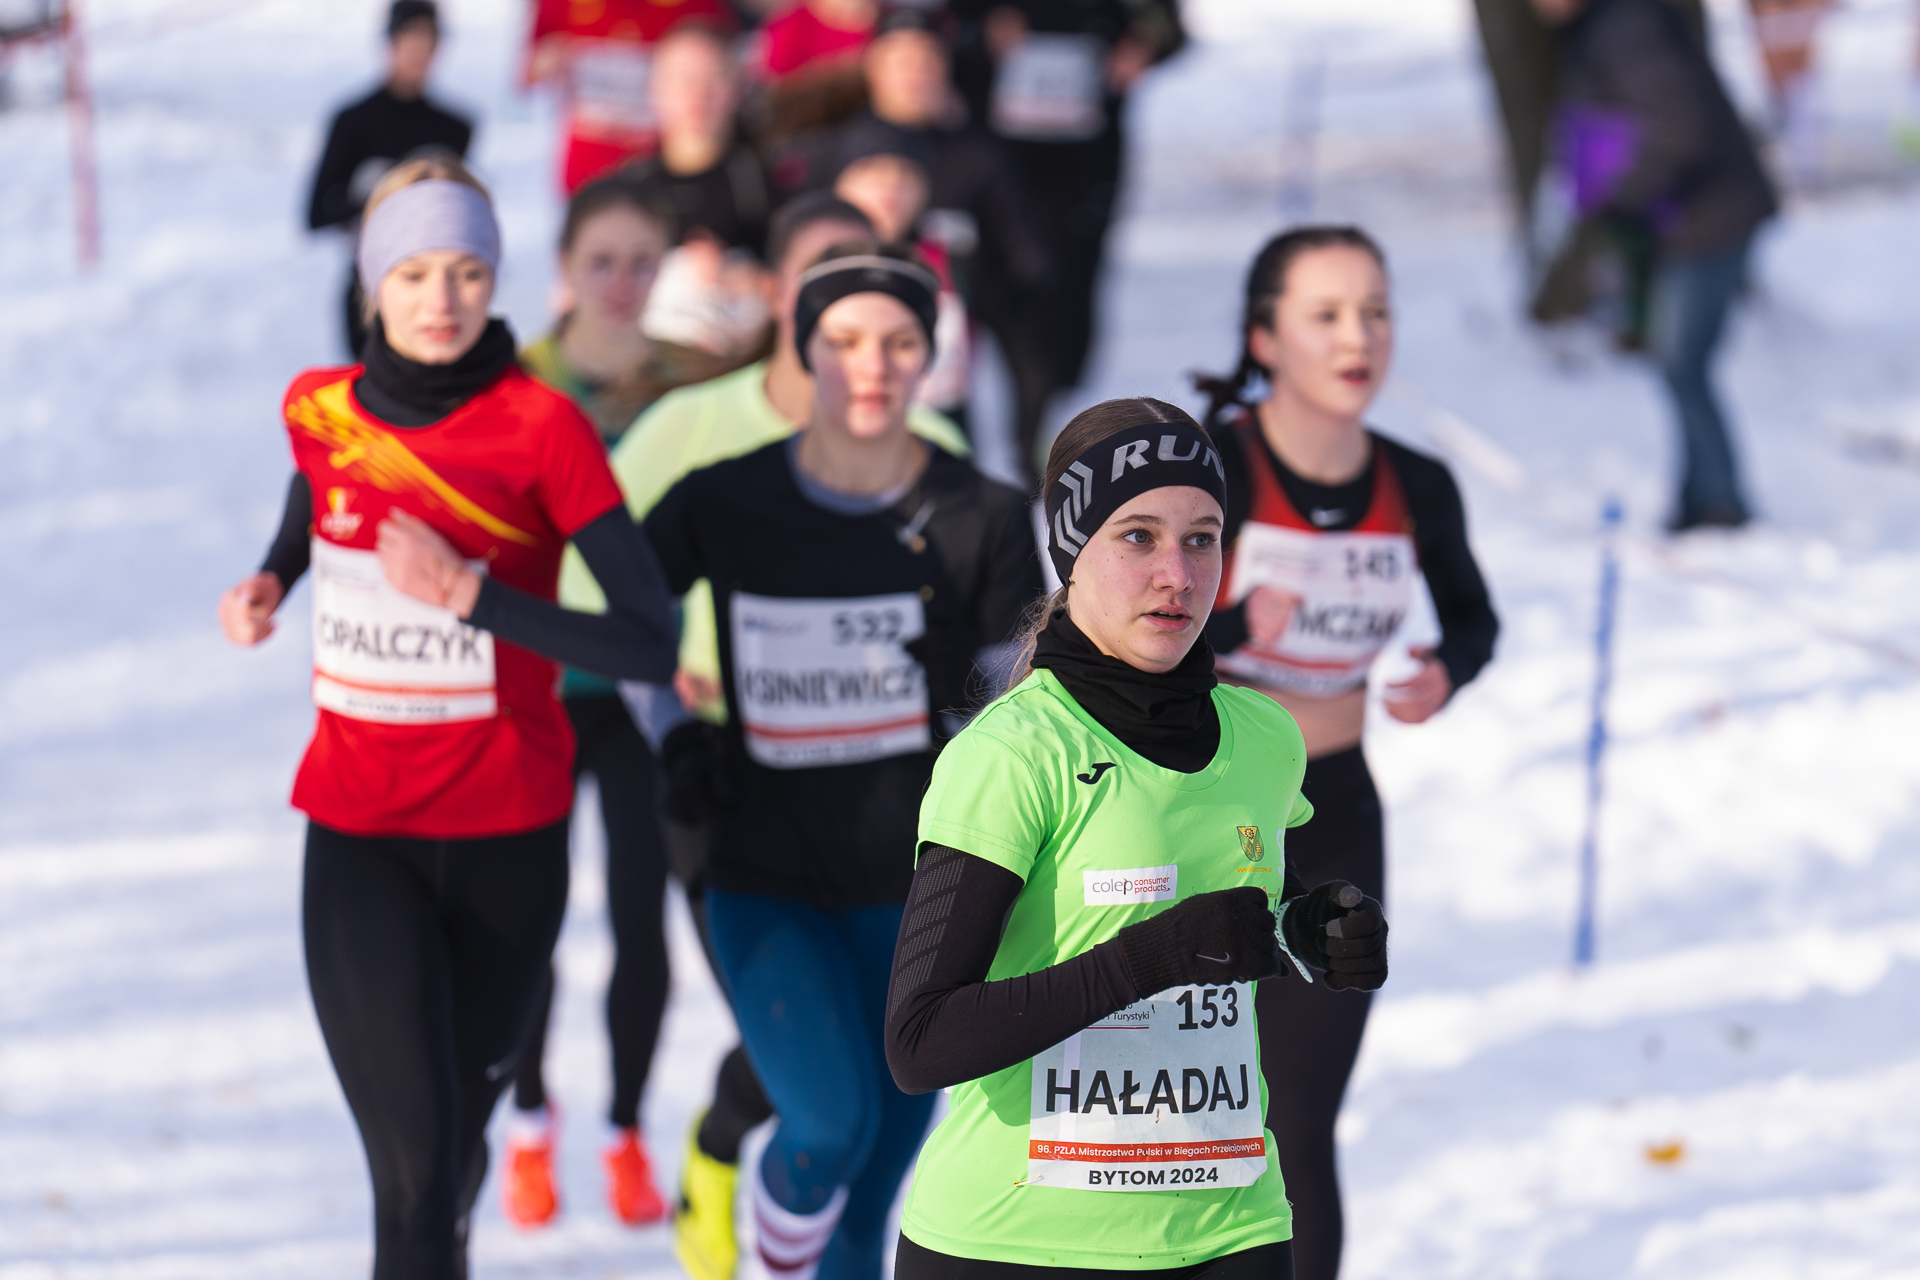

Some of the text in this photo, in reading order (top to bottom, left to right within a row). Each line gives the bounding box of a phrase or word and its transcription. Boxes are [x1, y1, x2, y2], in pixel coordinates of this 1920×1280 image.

[318, 612, 483, 665] OPALCZYK
[832, 609, 903, 643] 532
[1092, 877, 1170, 895] colep consumer
[1113, 1011, 1150, 1021] Turystyki
[1175, 987, 1239, 1030] 153
[1046, 1064, 1249, 1115] HAŁADAJ
[1037, 1144, 1052, 1154] 96.
[1054, 1146, 1076, 1155] PZLA
[1078, 1147, 1135, 1157] Mistrzostwa
[1136, 1147, 1163, 1157] Polski
[1174, 1146, 1211, 1157] Biegach
[1088, 1167, 1219, 1186] BYTOM 2024
